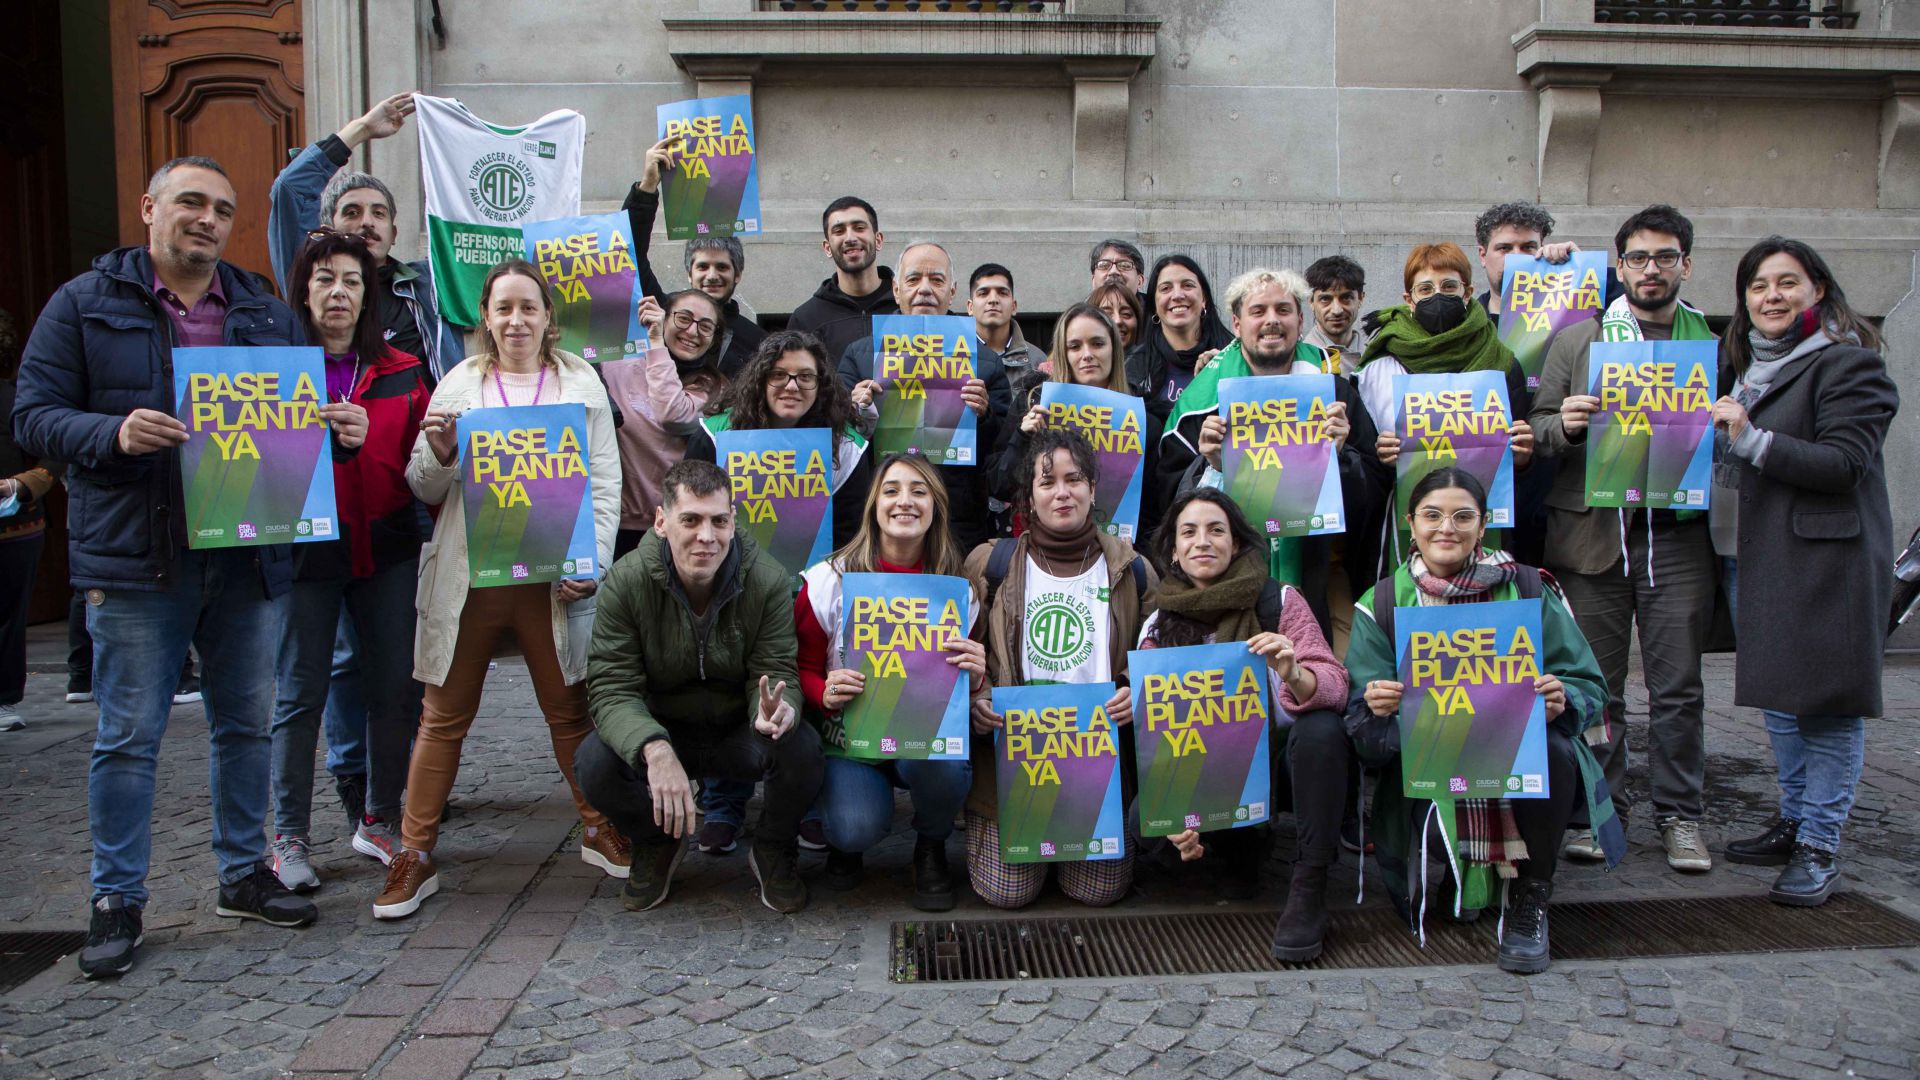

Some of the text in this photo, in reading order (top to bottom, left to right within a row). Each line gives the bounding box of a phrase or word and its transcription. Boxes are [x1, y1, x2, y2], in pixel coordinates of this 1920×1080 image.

[667, 114, 748, 140] PASE A
[524, 142, 554, 155] VERDE BLANCA
[469, 152, 536, 187] FORTALECER EL ESTADO
[679, 158, 711, 179] YA
[484, 168, 520, 206] ATE
[469, 188, 536, 223] PARA LIBERAR LA NACION
[453, 232, 526, 252] DEFENSORIA
[535, 230, 628, 262] PASE A
[455, 248, 501, 265] PUEBLO
[540, 250, 636, 282] PLANTA
[555, 280, 592, 304] YA
[1513, 268, 1600, 292] PASE A
[1511, 288, 1603, 312] PLANTA
[1521, 312, 1552, 332] YA
[1612, 310, 1621, 318] EL
[883, 335, 972, 357] PASE A
[883, 357, 976, 379] PLANTA
[1602, 362, 1710, 388] PASE A
[190, 372, 320, 401] PASE A
[894, 379, 927, 400] YA
[1601, 387, 1712, 412] PLANTA
[1230, 397, 1327, 426] PASE A
[1405, 389, 1505, 414] PASE A
[192, 401, 328, 432] PLANTA
[1049, 402, 1140, 432] PASE A
[1406, 411, 1510, 437] PLANTA
[1614, 411, 1653, 436] YA
[210, 431, 261, 461] YA
[471, 426, 581, 456] PASE A
[1419, 436, 1457, 460] YA
[472, 452, 589, 484] PLANTA
[728, 449, 826, 475] PASE A
[1245, 447, 1283, 470] YA
[488, 482, 532, 508] YA
[730, 474, 831, 501] PLANTA
[742, 500, 778, 523] YA
[854, 596, 962, 625] PASE A
[1066, 595, 1076, 607] EL
[1075, 602, 1095, 632] ESTADO
[1035, 609, 1078, 653] ATE
[1410, 625, 1536, 659] PASE A
[866, 651, 907, 679] YA
[1028, 640, 1094, 672] LIBERAR LA NACION
[1144, 666, 1261, 703] PASE A
[1412, 655, 1540, 688] PLANTA
[1147, 694, 1267, 731] PLANTA
[1427, 686, 1476, 716] YA
[1006, 705, 1112, 734] PASE A
[1008, 731, 1118, 760] PLANTA
[1162, 728, 1208, 757] YA
[1021, 759, 1061, 786] YA
